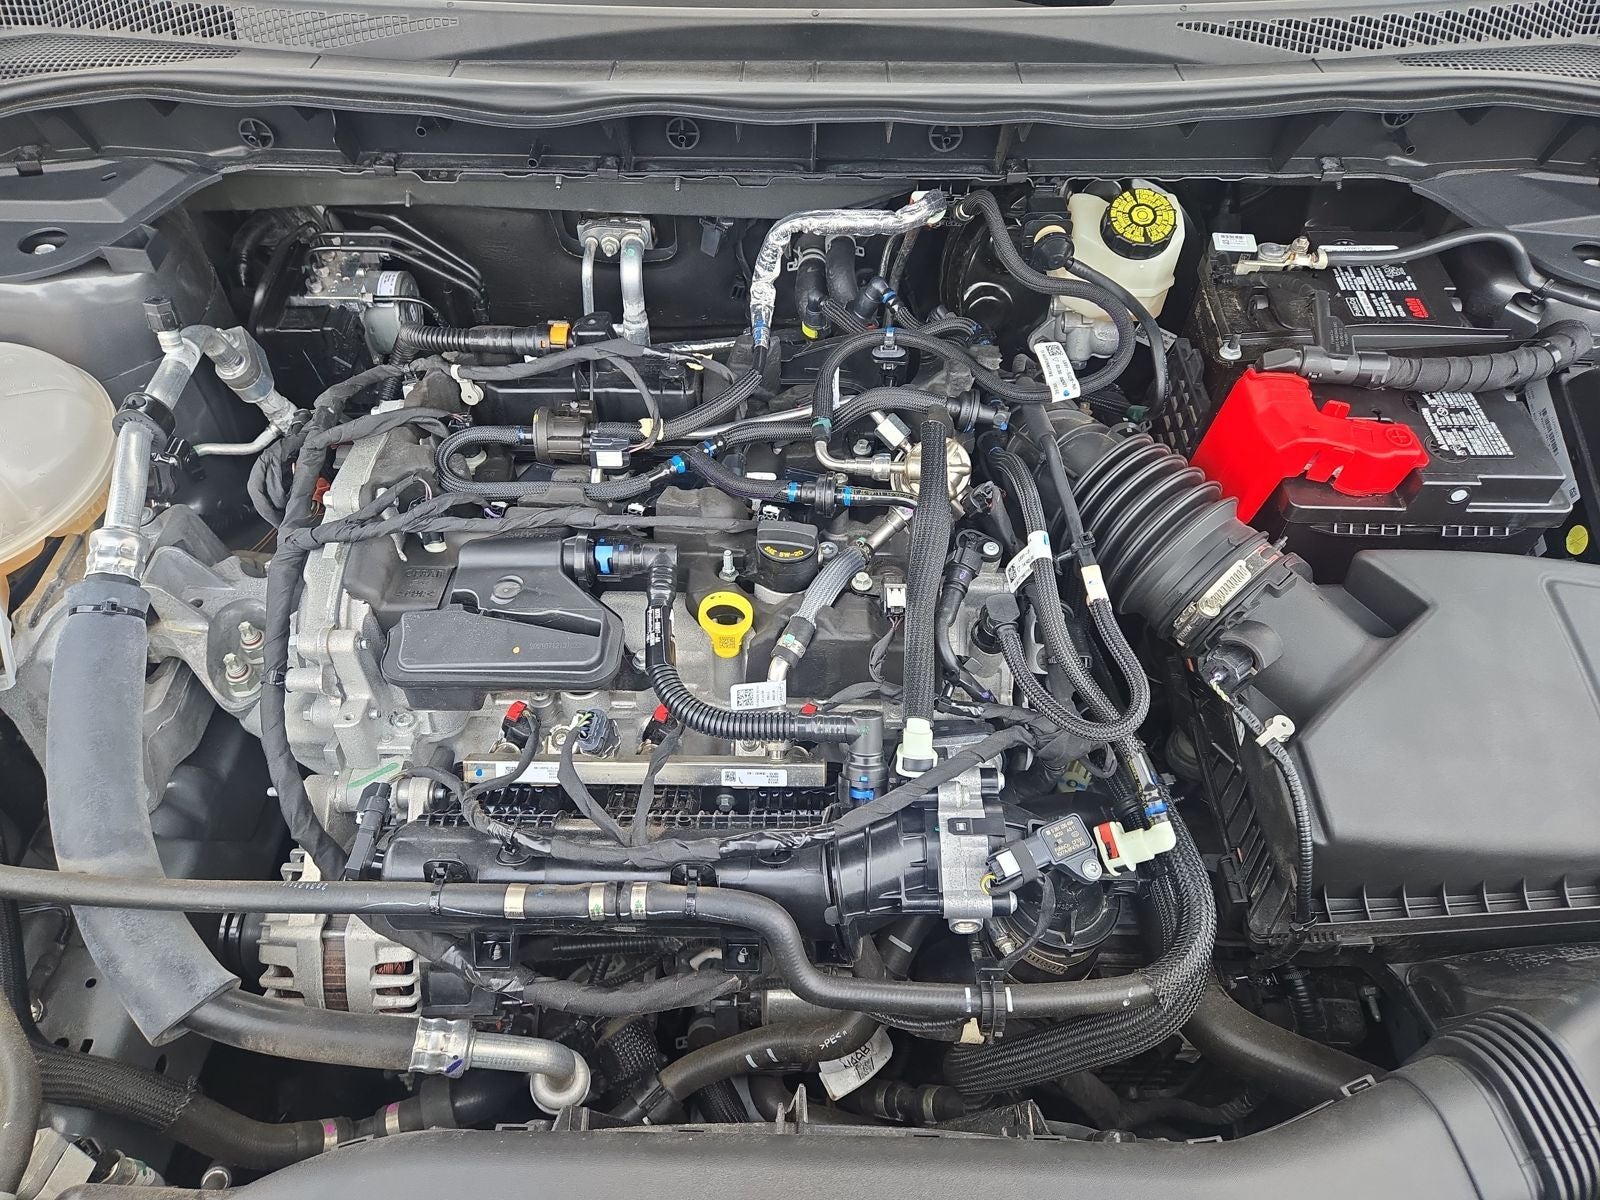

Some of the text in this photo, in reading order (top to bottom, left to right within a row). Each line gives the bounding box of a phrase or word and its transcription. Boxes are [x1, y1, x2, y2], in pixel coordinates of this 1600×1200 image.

[1405, 298, 1425, 317] AGM
[764, 546, 804, 558] SAE 5W-20
[818, 1031, 842, 1050] >PE<
